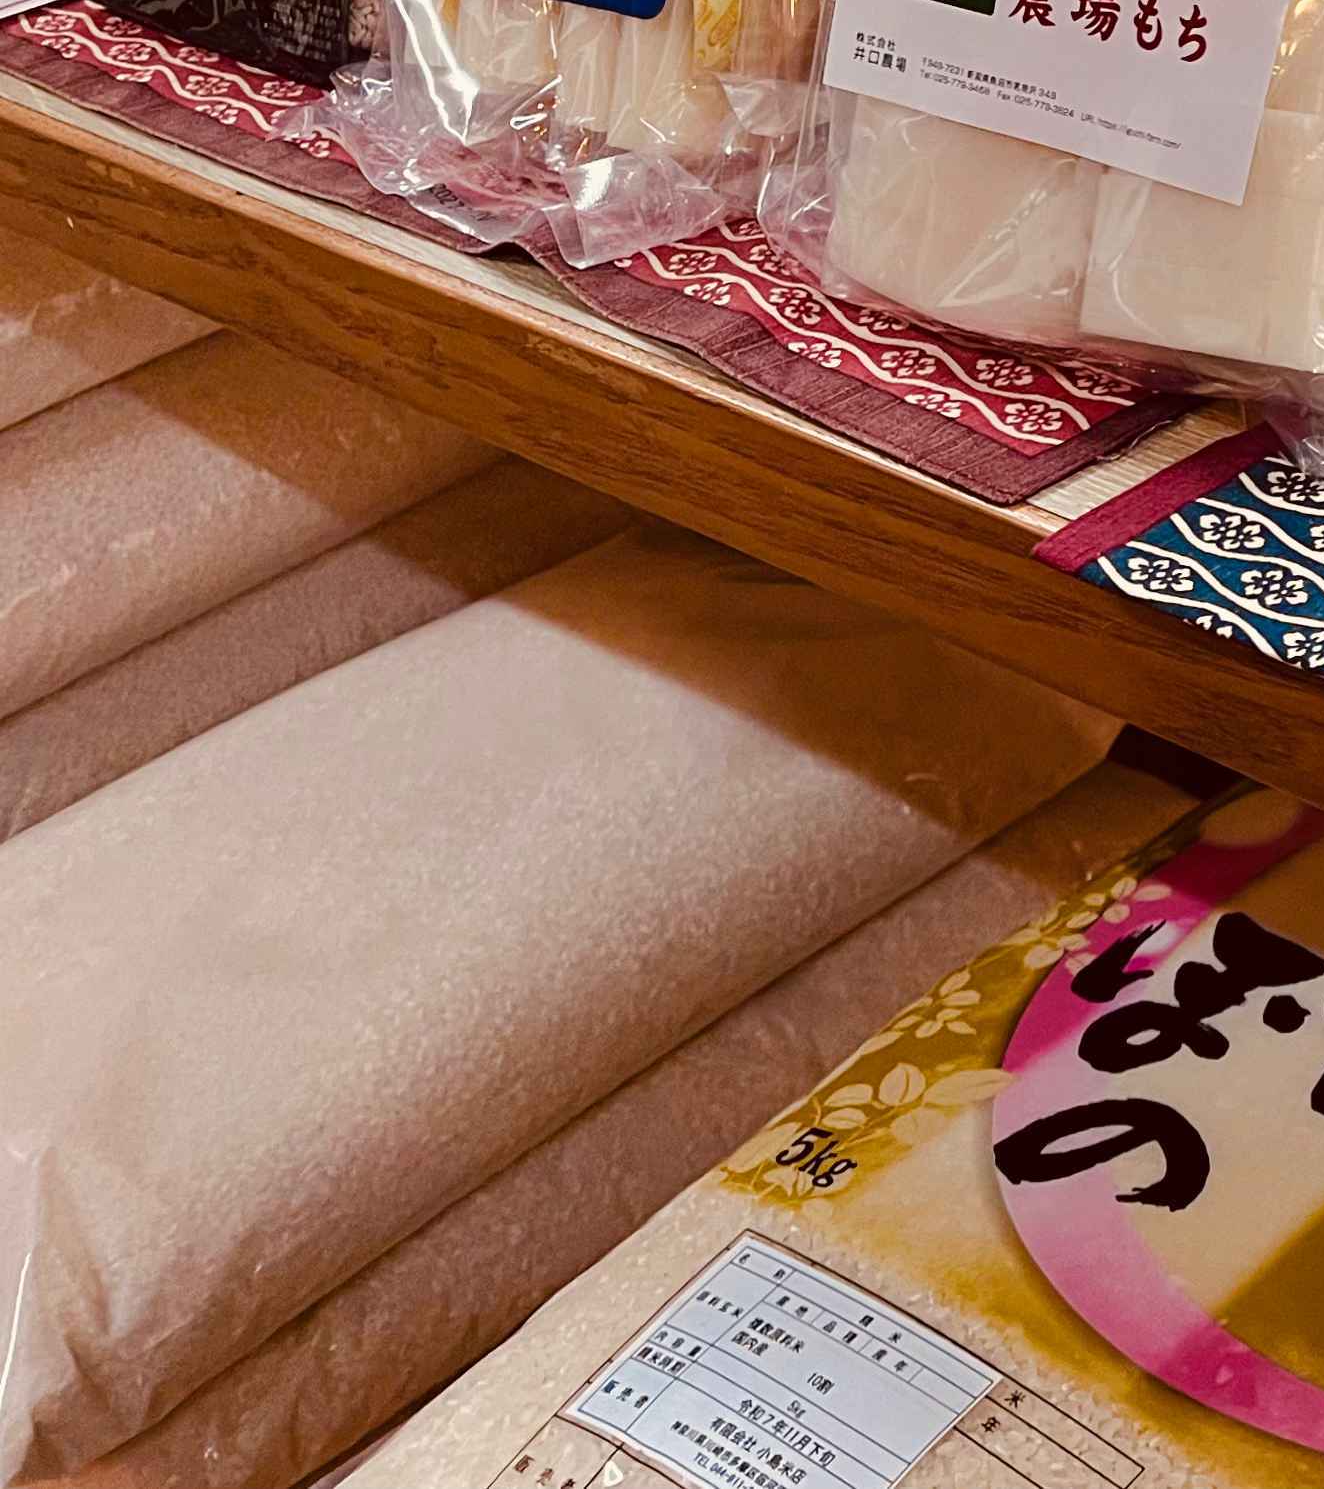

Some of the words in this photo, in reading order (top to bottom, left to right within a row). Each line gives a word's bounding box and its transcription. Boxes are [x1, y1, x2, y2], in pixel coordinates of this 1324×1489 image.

[856, 31, 896, 52] 株式会社
[853, 46, 908, 73] 井口農場
[774, 1124, 860, 1193] 5kg
